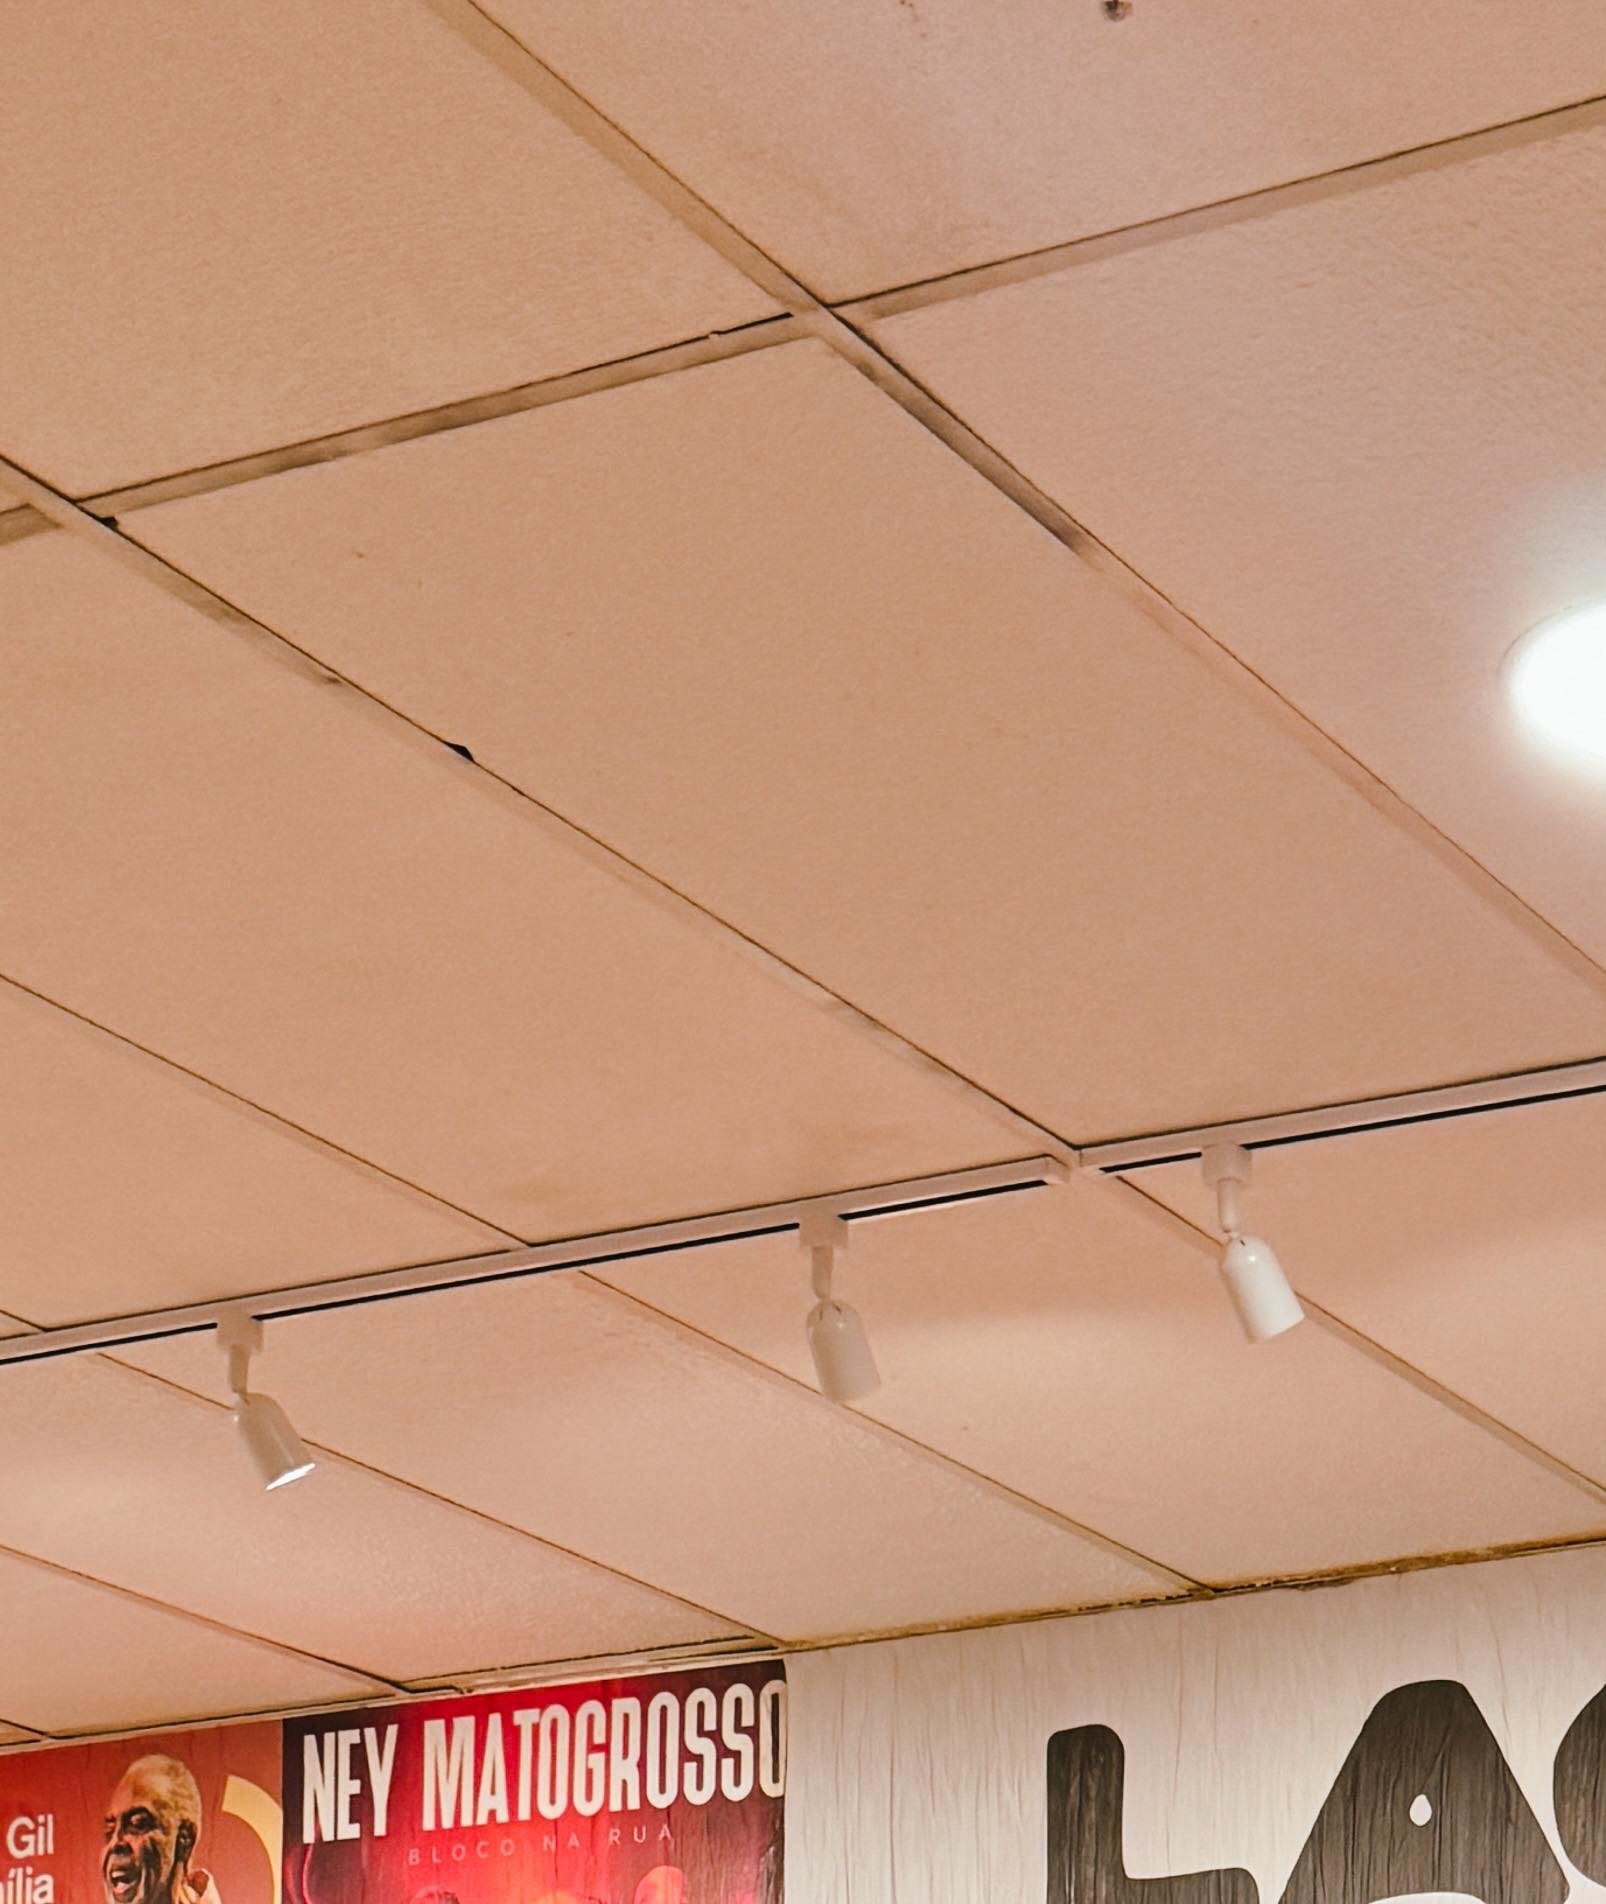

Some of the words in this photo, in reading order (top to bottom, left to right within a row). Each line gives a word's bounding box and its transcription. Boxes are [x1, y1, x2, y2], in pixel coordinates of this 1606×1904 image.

[302, 1724, 399, 1845] NEY
[422, 1679, 787, 1832] MATOGROSSO
[6, 1813, 55, 1860] Gil
[408, 1839, 515, 1866] BLOCO
[543, 1832, 580, 1852] NA
[608, 1824, 671, 1846] RUA
